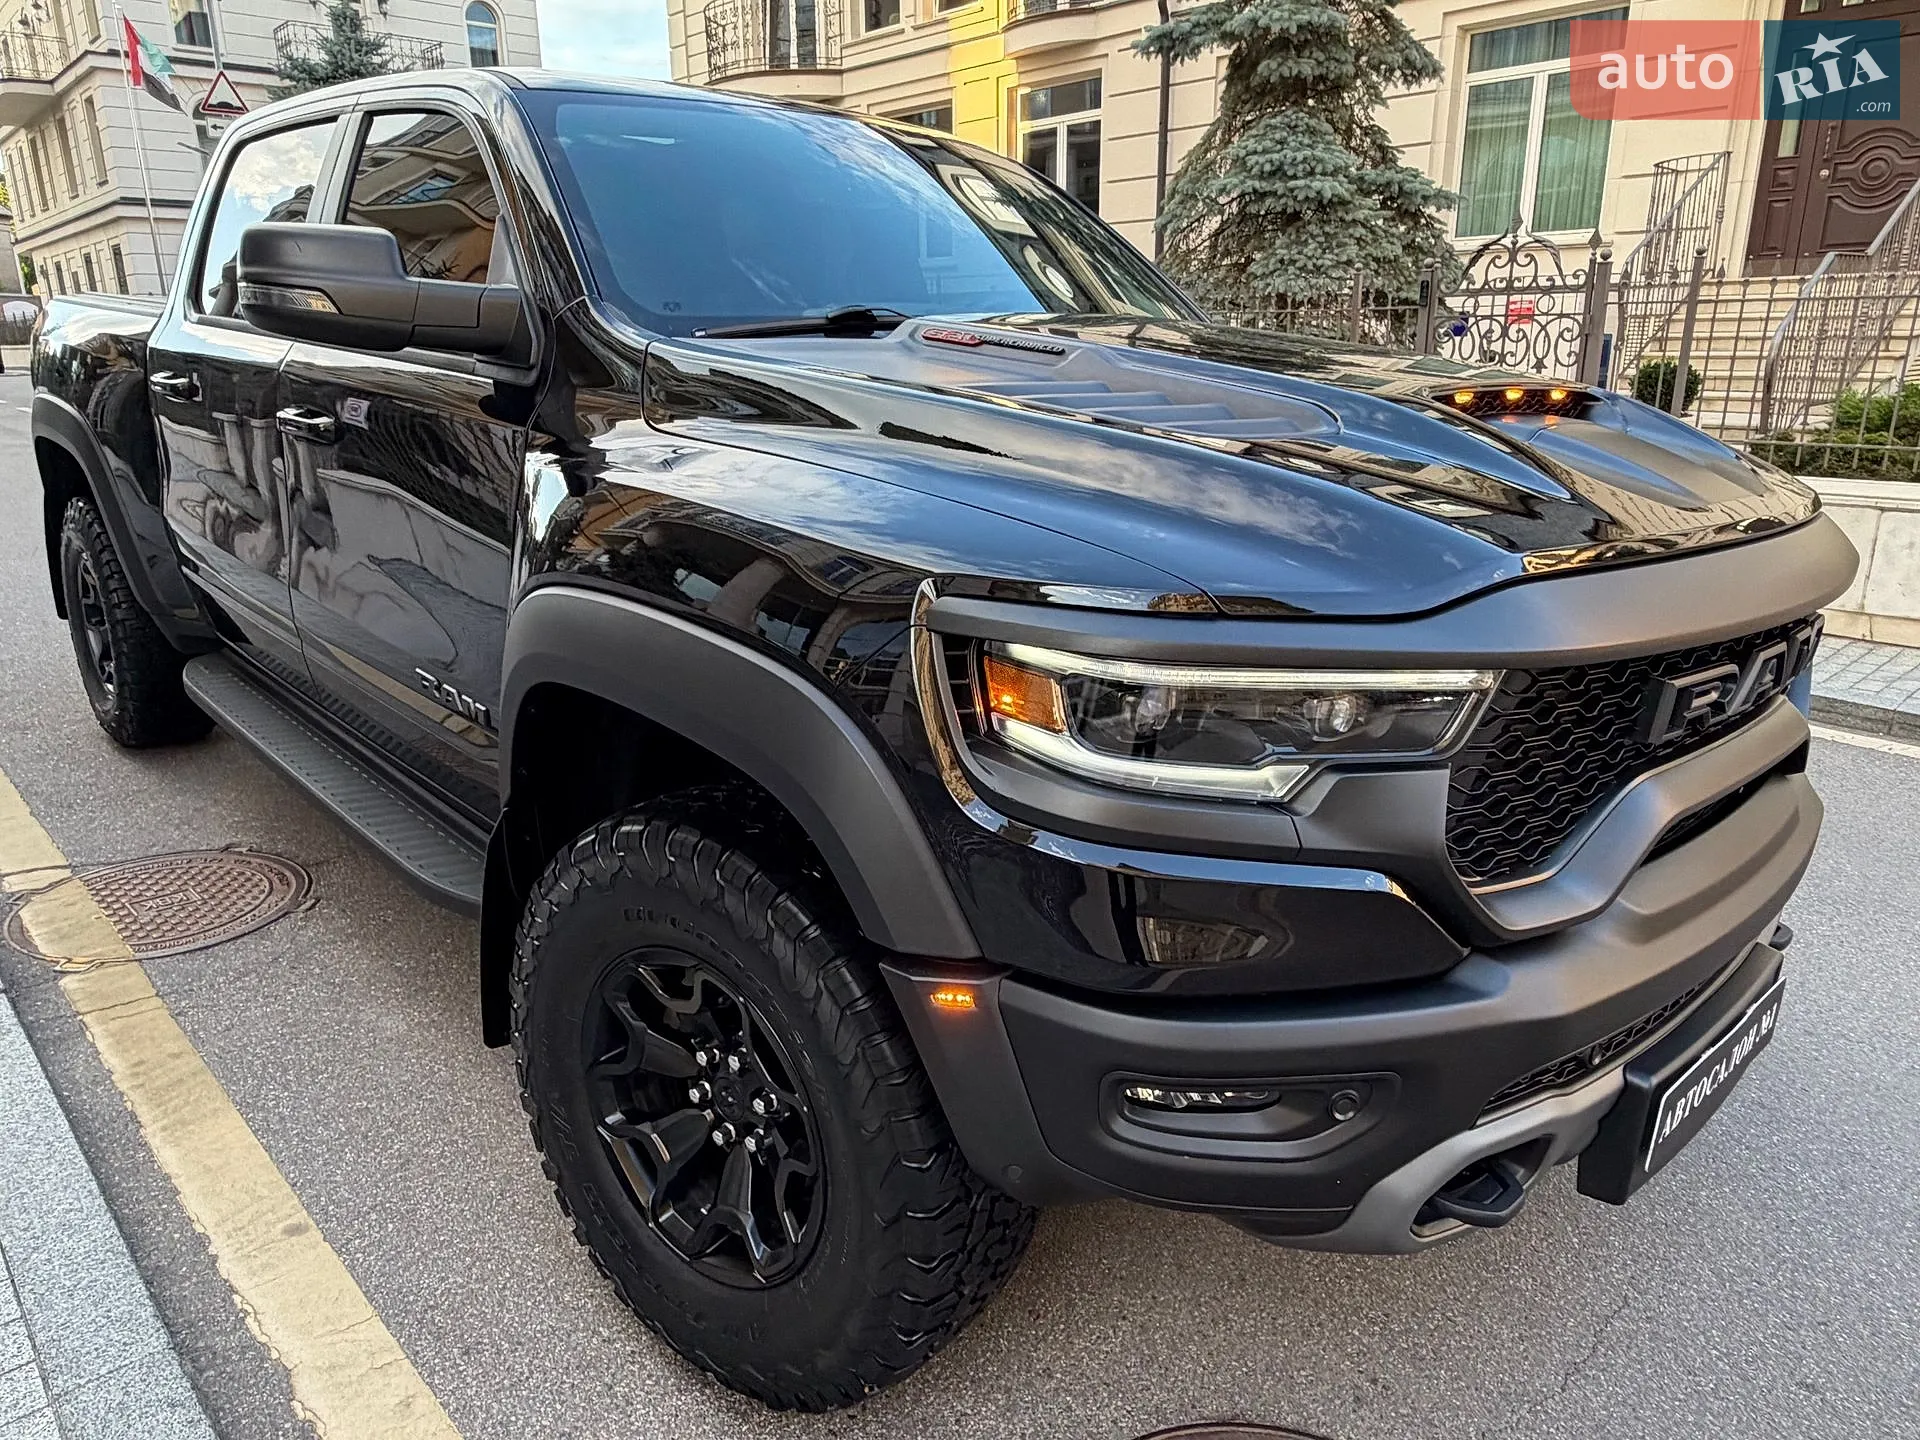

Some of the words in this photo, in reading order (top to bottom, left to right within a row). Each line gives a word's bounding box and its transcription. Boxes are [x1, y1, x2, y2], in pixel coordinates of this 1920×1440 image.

[415, 667, 490, 728] RAM
[1650, 613, 1825, 746] RAM
[1658, 1023, 1758, 1144] АВТОСАЛОН
